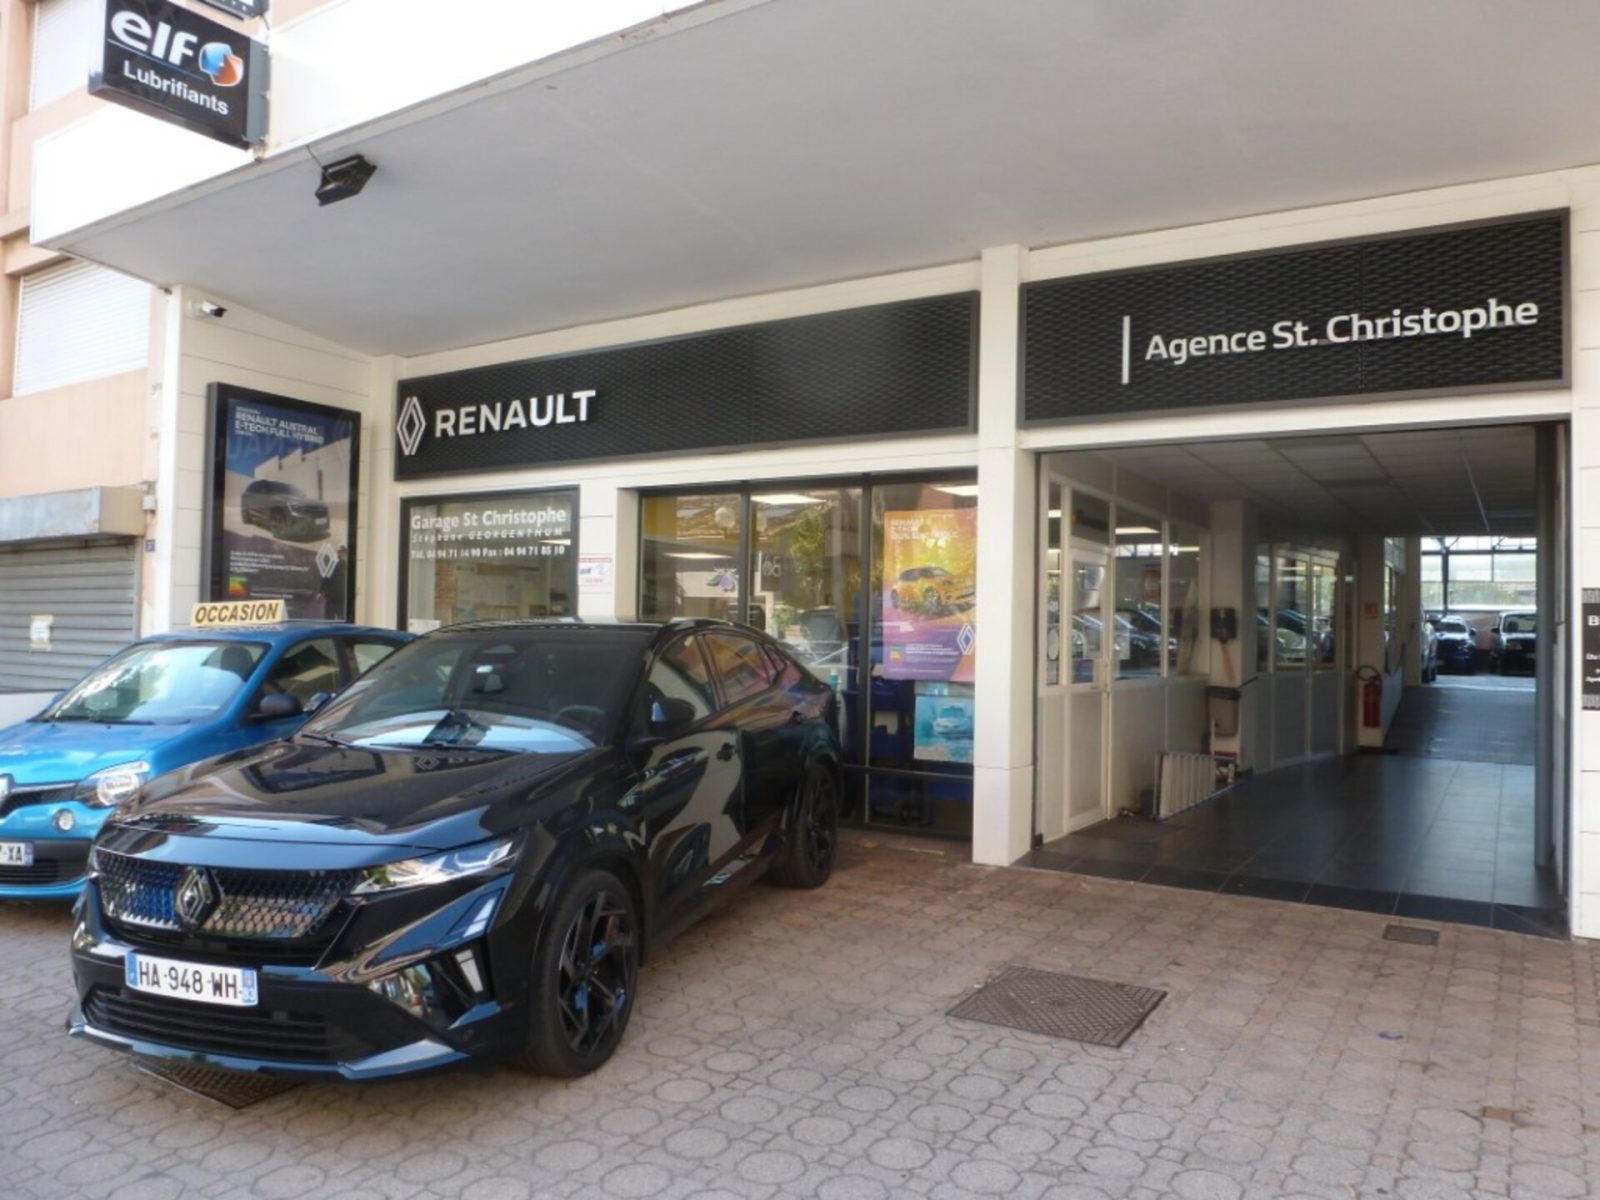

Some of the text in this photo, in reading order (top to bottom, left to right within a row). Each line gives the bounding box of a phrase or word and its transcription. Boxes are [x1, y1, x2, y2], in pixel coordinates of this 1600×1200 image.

[111, 10, 198, 66] elf
[123, 60, 229, 115] Lubrifiants
[1145, 298, 1539, 365] Agence St. Christophe
[234, 421, 269, 433] E-TECH
[270, 427, 291, 438] FULL
[235, 411, 318, 434] RENAULT AUSTRAL
[435, 389, 596, 438] RENAULT
[411, 506, 567, 532] Garage St Christophe
[194, 602, 280, 624] OCCASION
